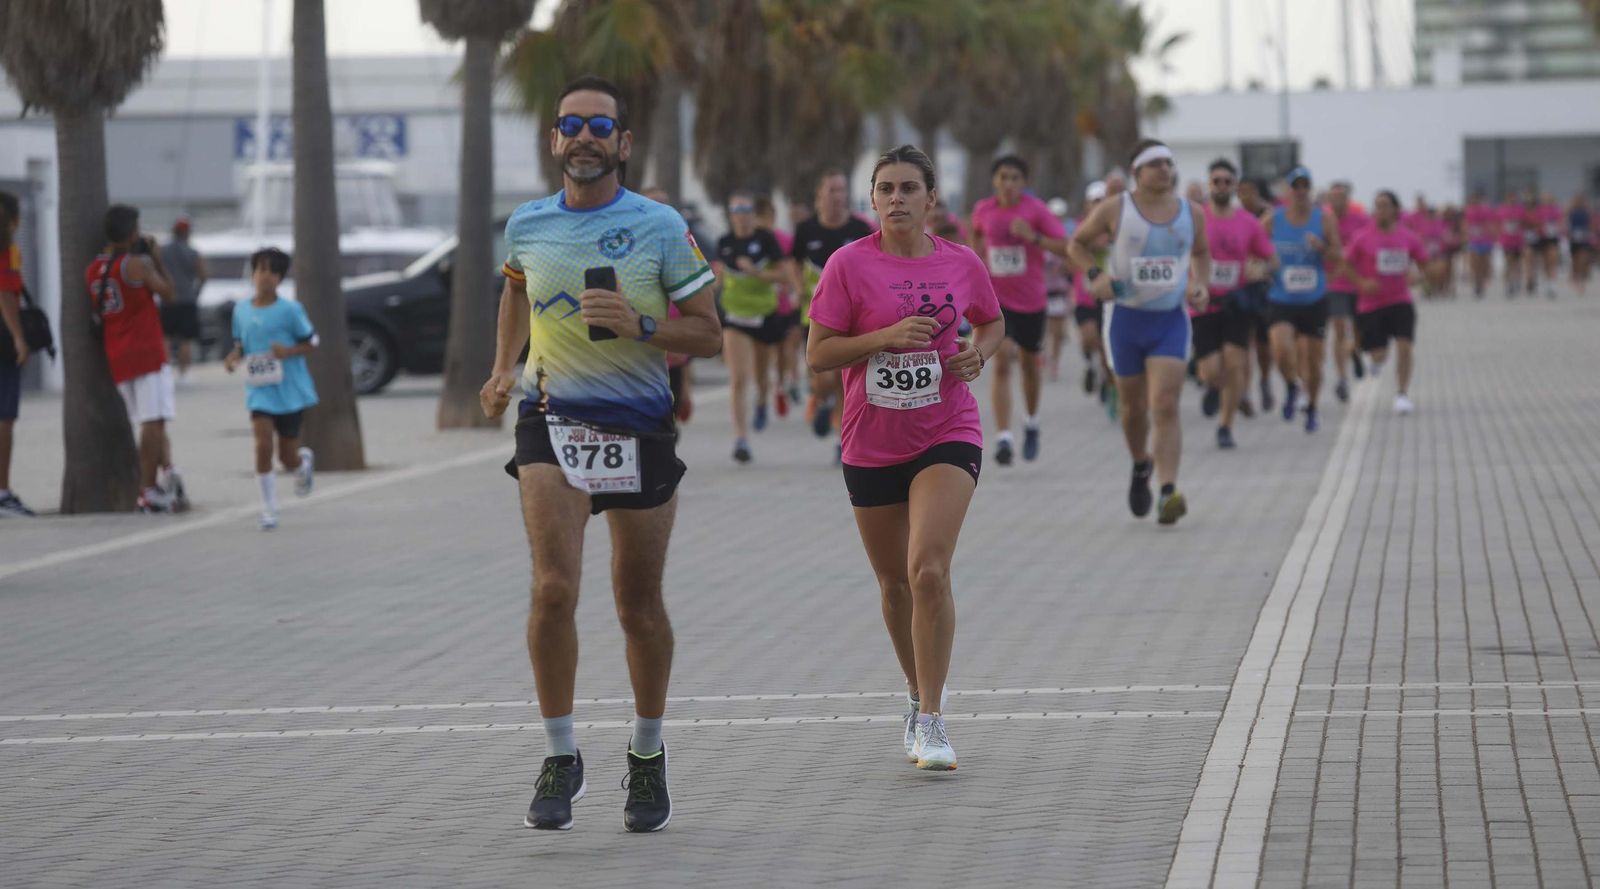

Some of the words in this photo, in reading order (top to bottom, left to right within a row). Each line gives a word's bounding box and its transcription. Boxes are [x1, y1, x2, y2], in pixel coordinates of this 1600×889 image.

[1138, 265, 1173, 281] 880
[886, 360, 900, 369] POR
[913, 357, 937, 366] MUJER
[876, 367, 932, 391] 398
[568, 434, 585, 442] POR
[588, 434, 600, 442] LA
[562, 443, 624, 470] 878
